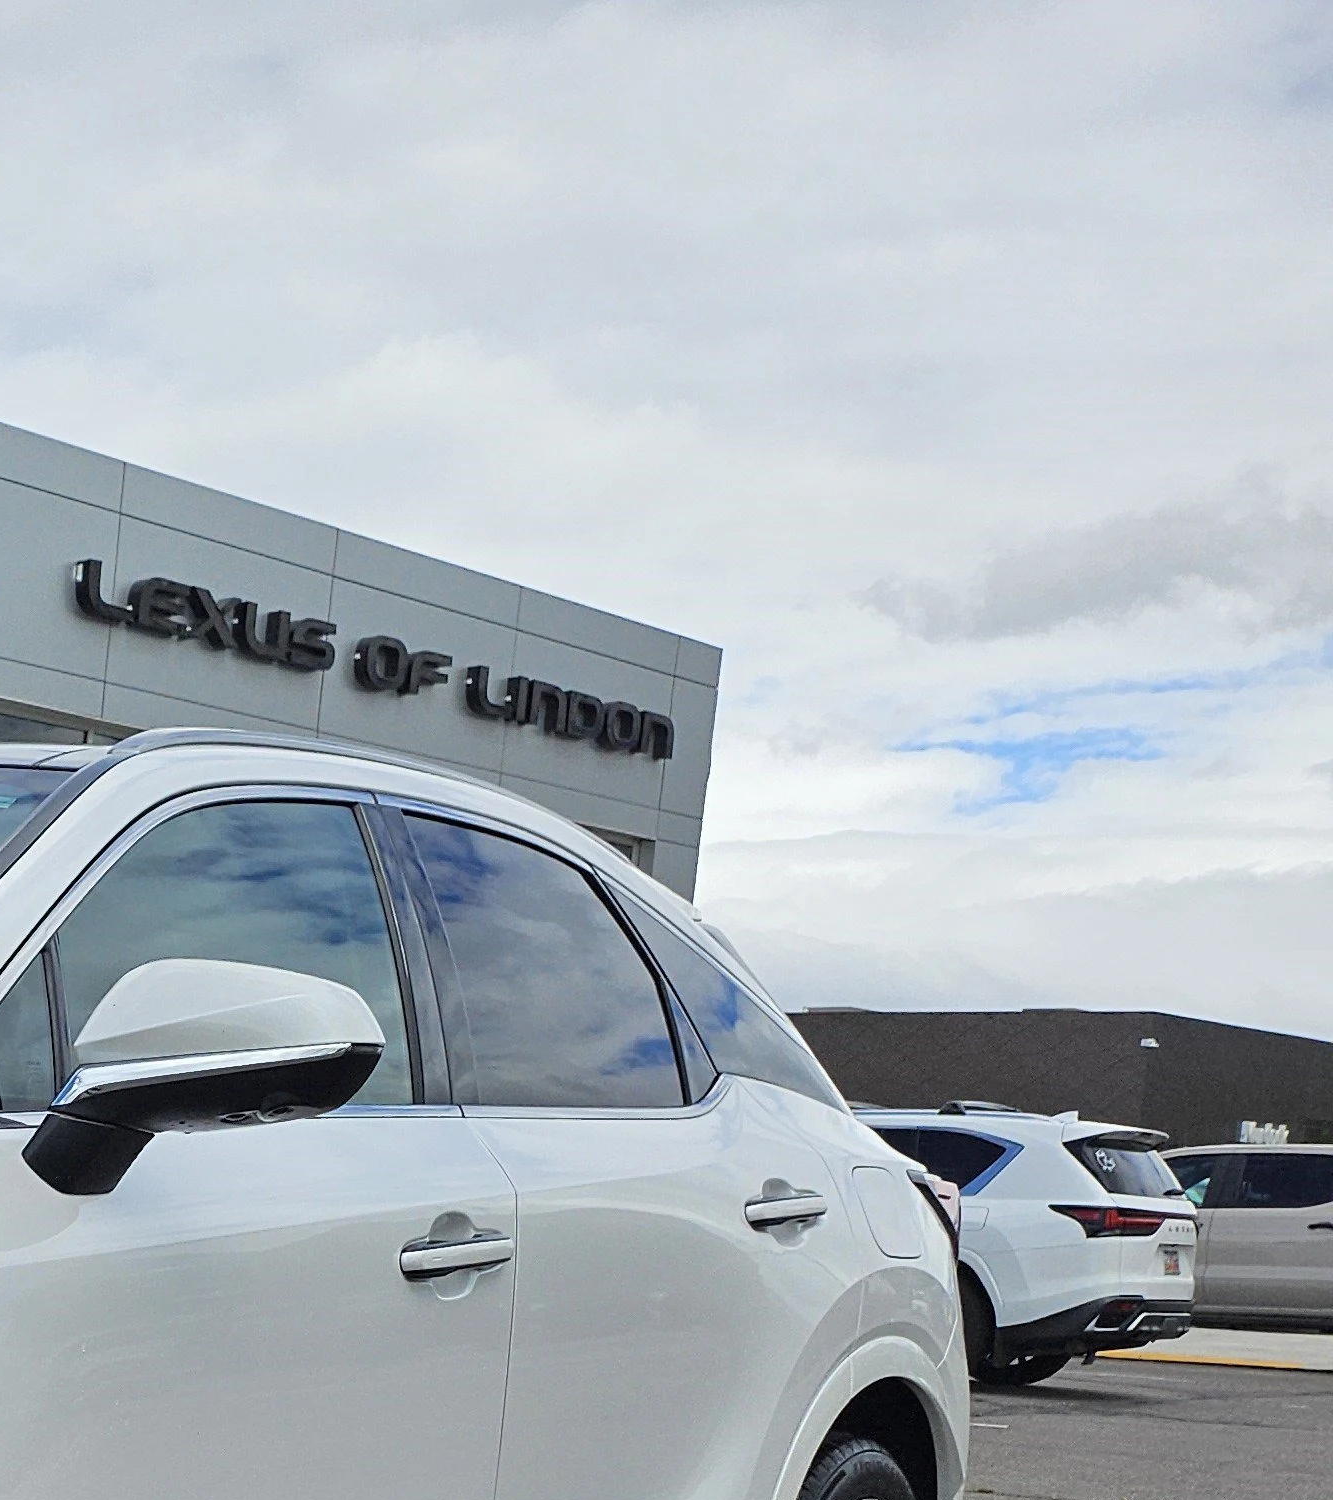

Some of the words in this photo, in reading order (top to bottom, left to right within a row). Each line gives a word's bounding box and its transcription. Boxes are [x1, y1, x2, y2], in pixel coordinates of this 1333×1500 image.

[74, 559, 337, 672] LEXUS
[354, 635, 453, 695] OF
[465, 665, 675, 760] LINDON
